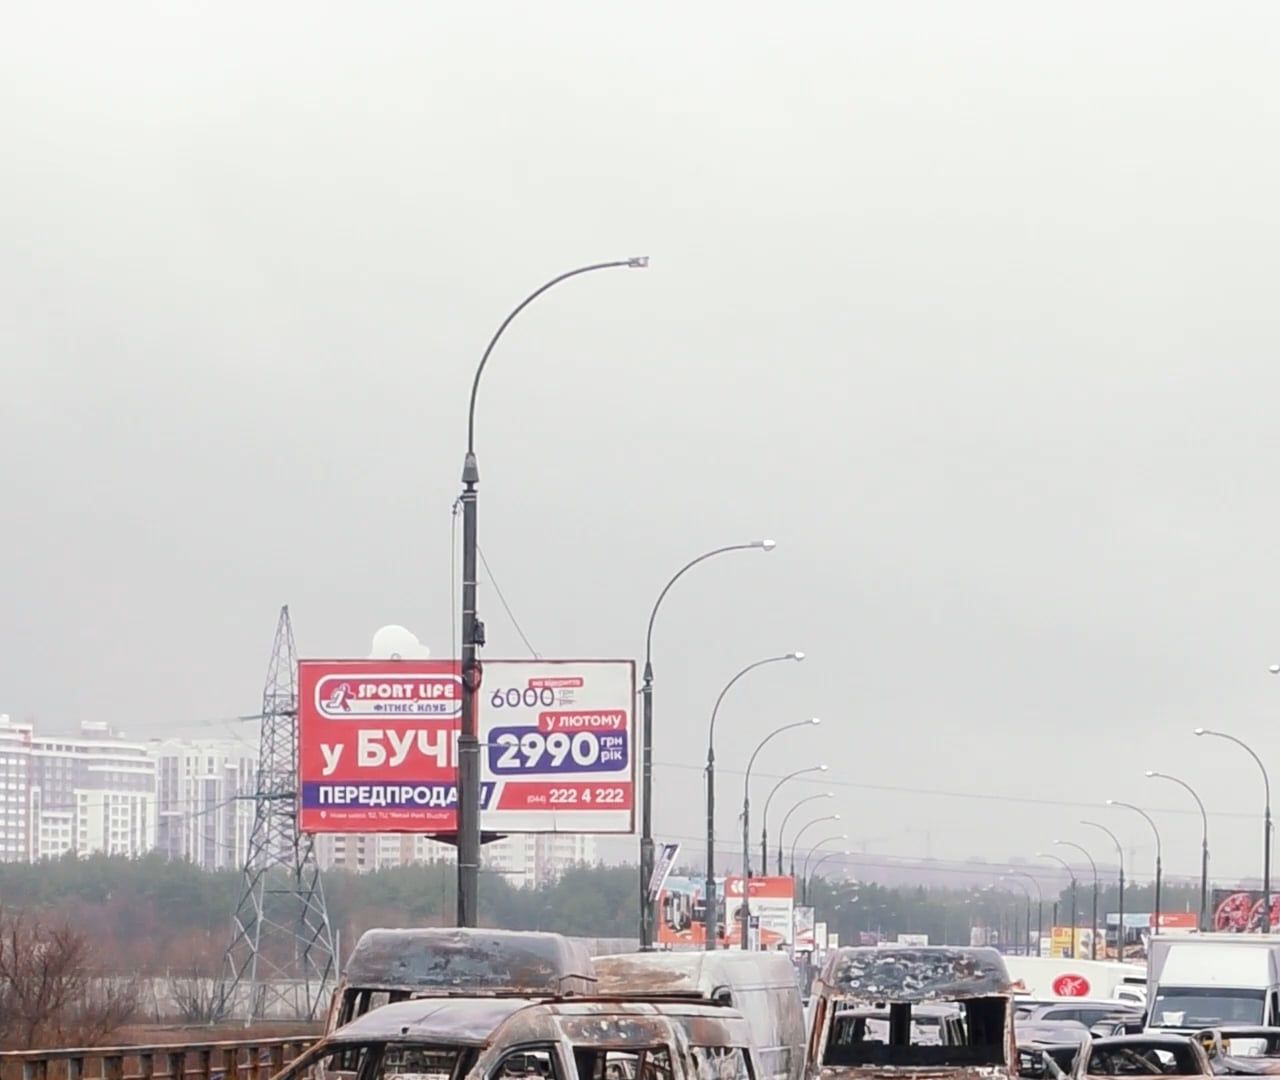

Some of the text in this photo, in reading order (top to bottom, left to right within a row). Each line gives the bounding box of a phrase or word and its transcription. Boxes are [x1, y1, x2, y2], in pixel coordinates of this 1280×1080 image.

[358, 683, 454, 698] SPORT LIFE
[491, 688, 554, 708] 6000
[496, 731, 599, 768] 2990
[600, 736, 623, 751] грн
[549, 788, 577, 803] 222
[581, 788, 591, 803] 4
[596, 788, 624, 803] 222
